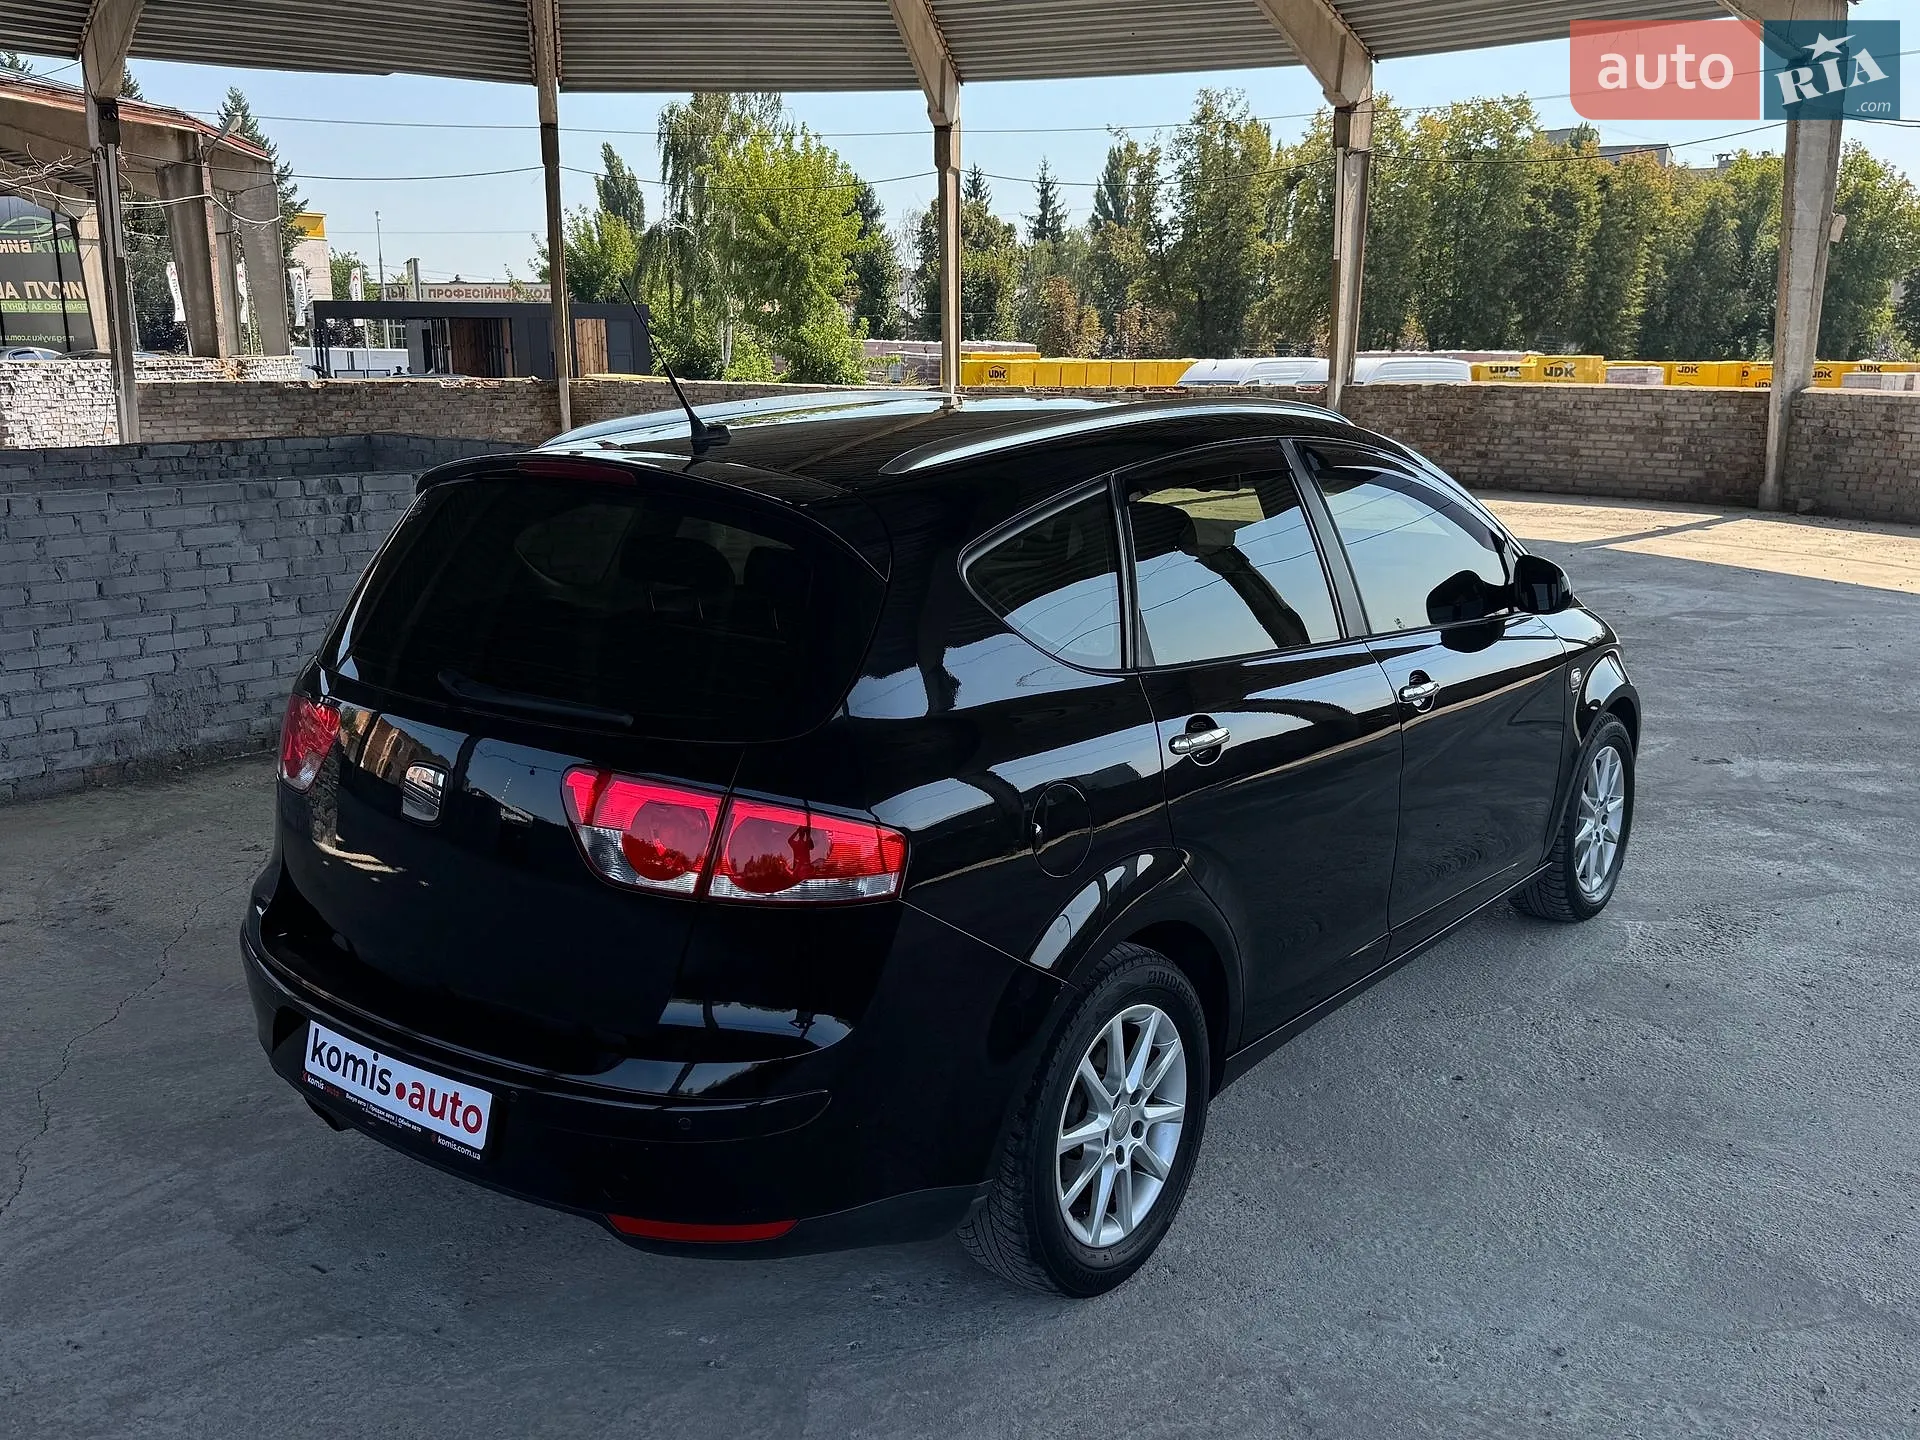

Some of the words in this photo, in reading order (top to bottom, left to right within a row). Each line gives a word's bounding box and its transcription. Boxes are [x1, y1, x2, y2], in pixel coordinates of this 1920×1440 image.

[988, 369, 1007, 379] UDK
[1544, 367, 1577, 379] UDK
[437, 1135, 481, 1161] komis.com.ua
